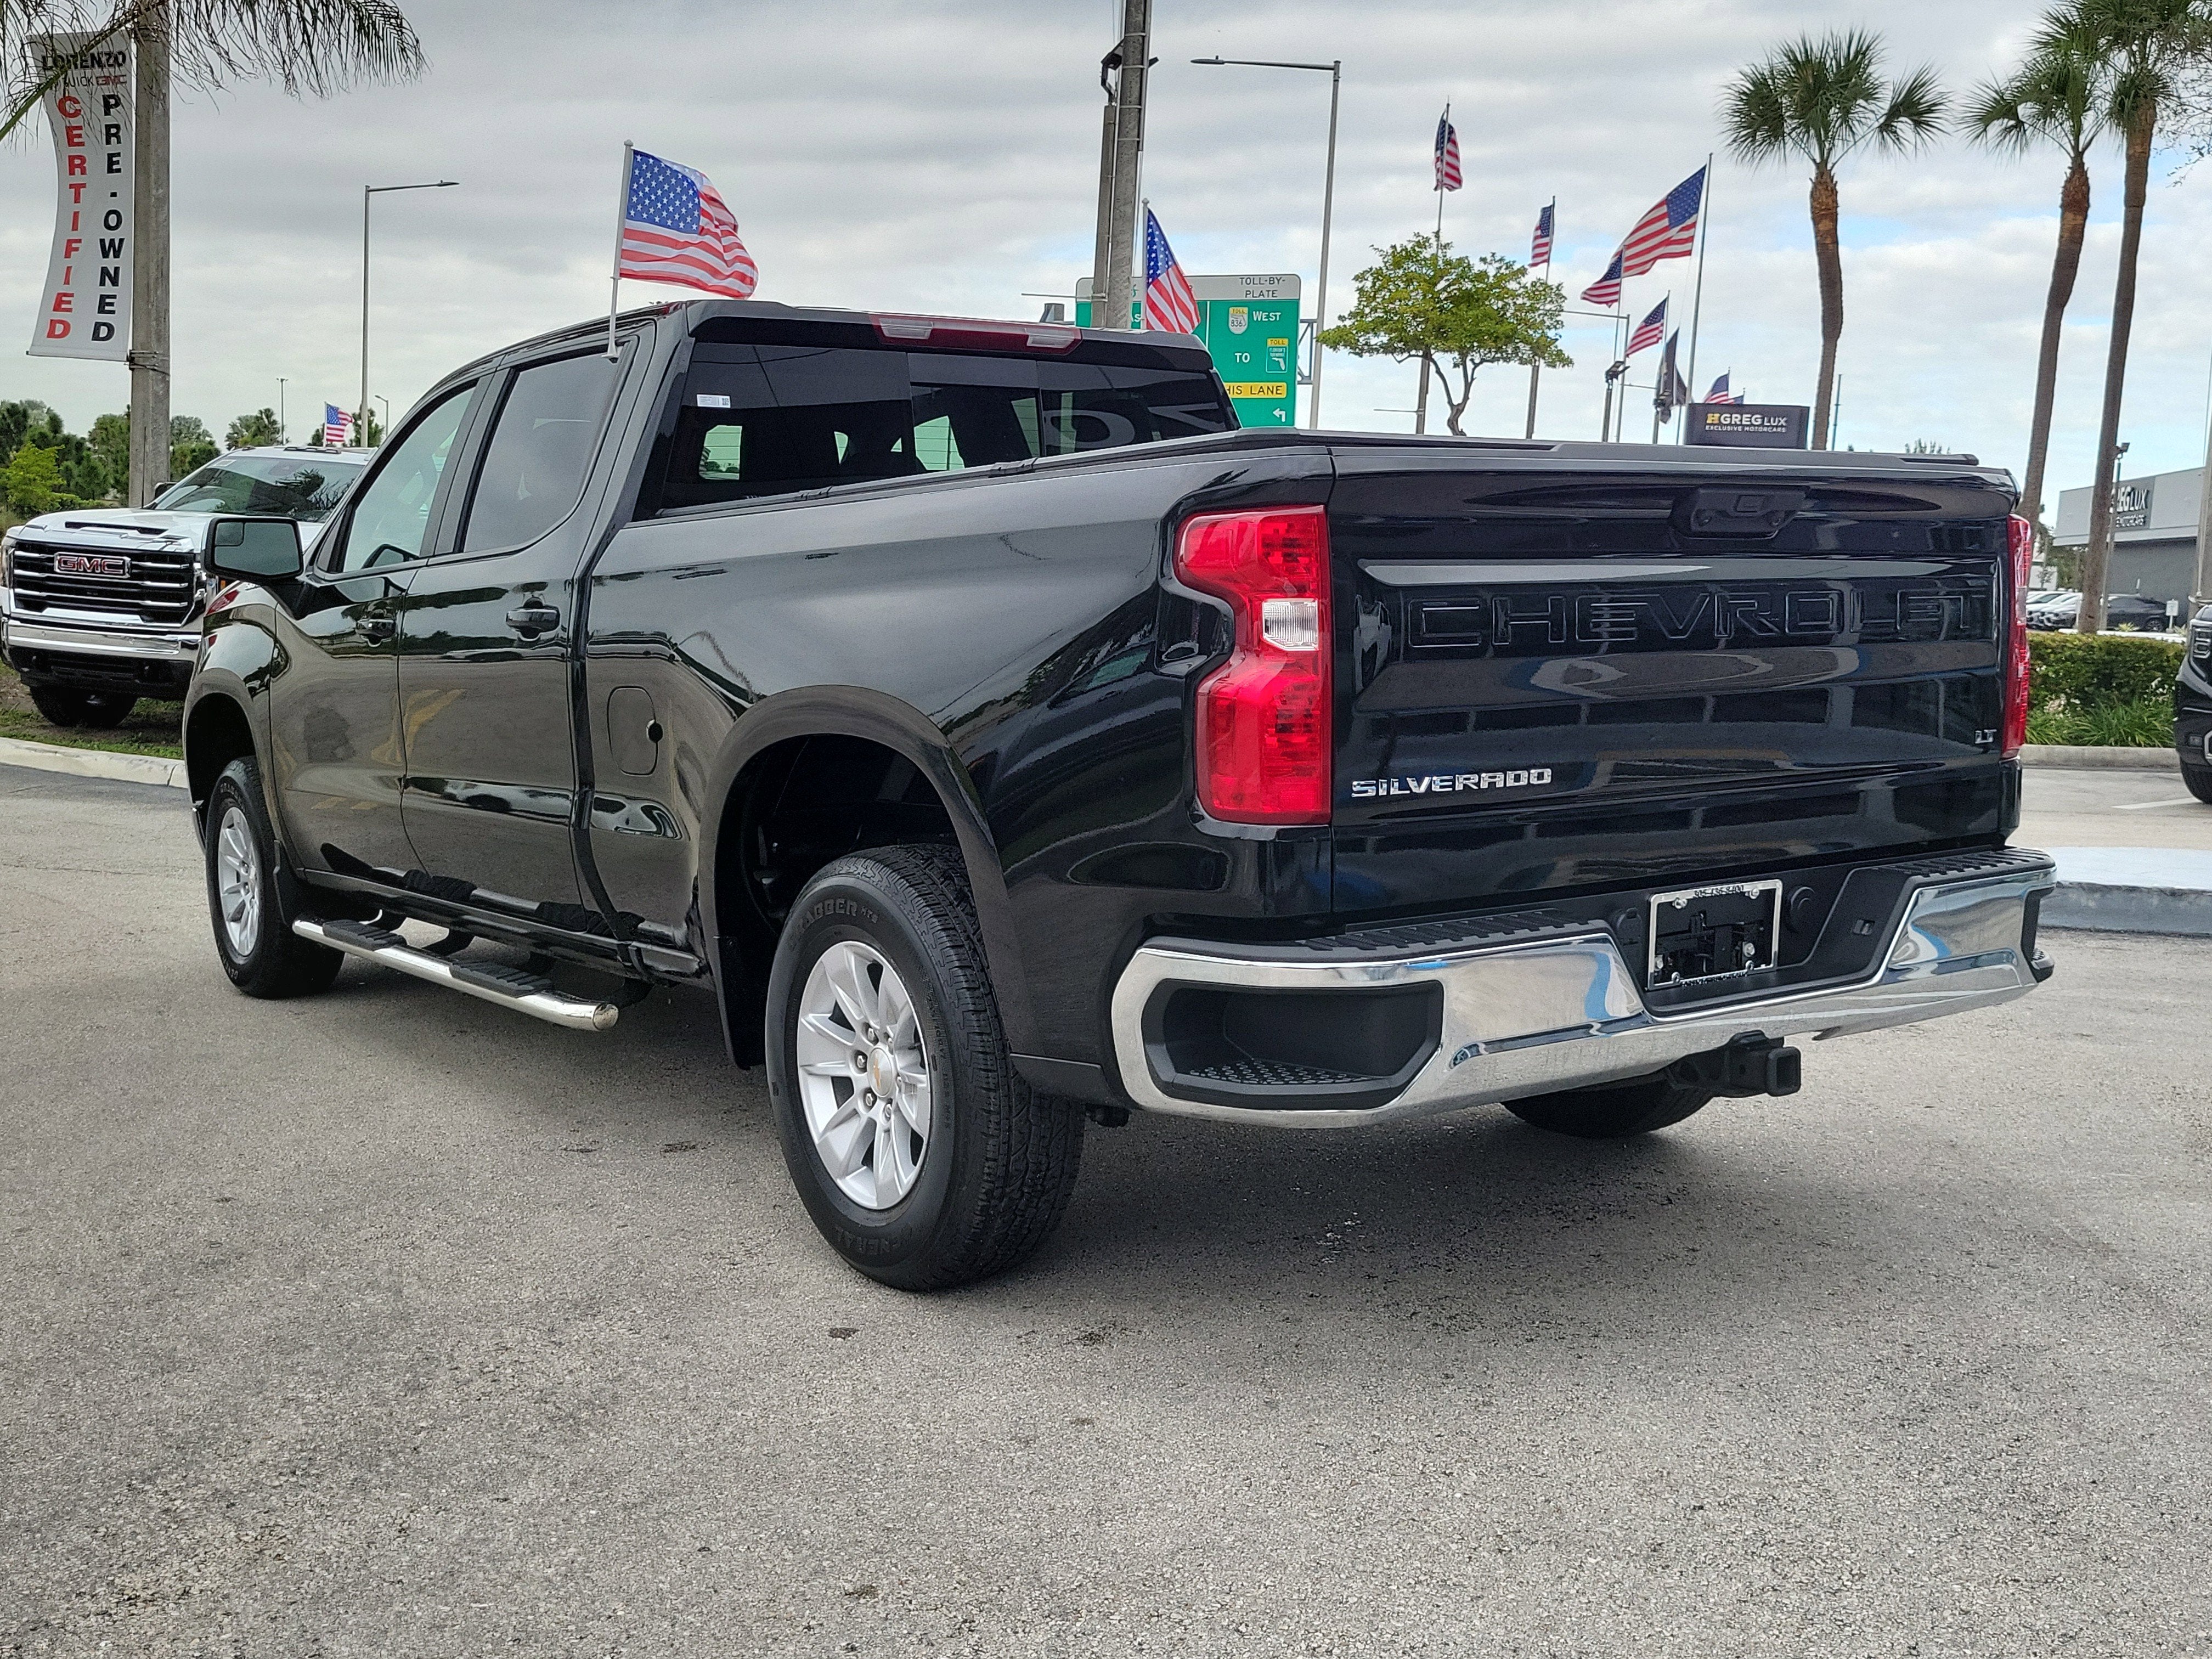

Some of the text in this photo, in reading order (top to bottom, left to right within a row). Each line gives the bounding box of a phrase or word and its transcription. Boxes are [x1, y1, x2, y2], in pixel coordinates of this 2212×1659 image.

[46, 95, 87, 340] CERTIFIED
[1239, 277, 1285, 285] TOLL-BY-
[1245, 290, 1278, 298] PLATE
[1253, 311, 1282, 321] WEST
[1234, 353, 1250, 363] TO
[1250, 385, 1283, 395] LANE
[1764, 416, 1787, 426] LUX
[2130, 489, 2147, 511] LUX
[58, 555, 123, 574] GMC
[1408, 587, 1988, 648] CHEVROLET
[1975, 729, 1997, 744] LT
[1351, 768, 1552, 798] SILVERADO
